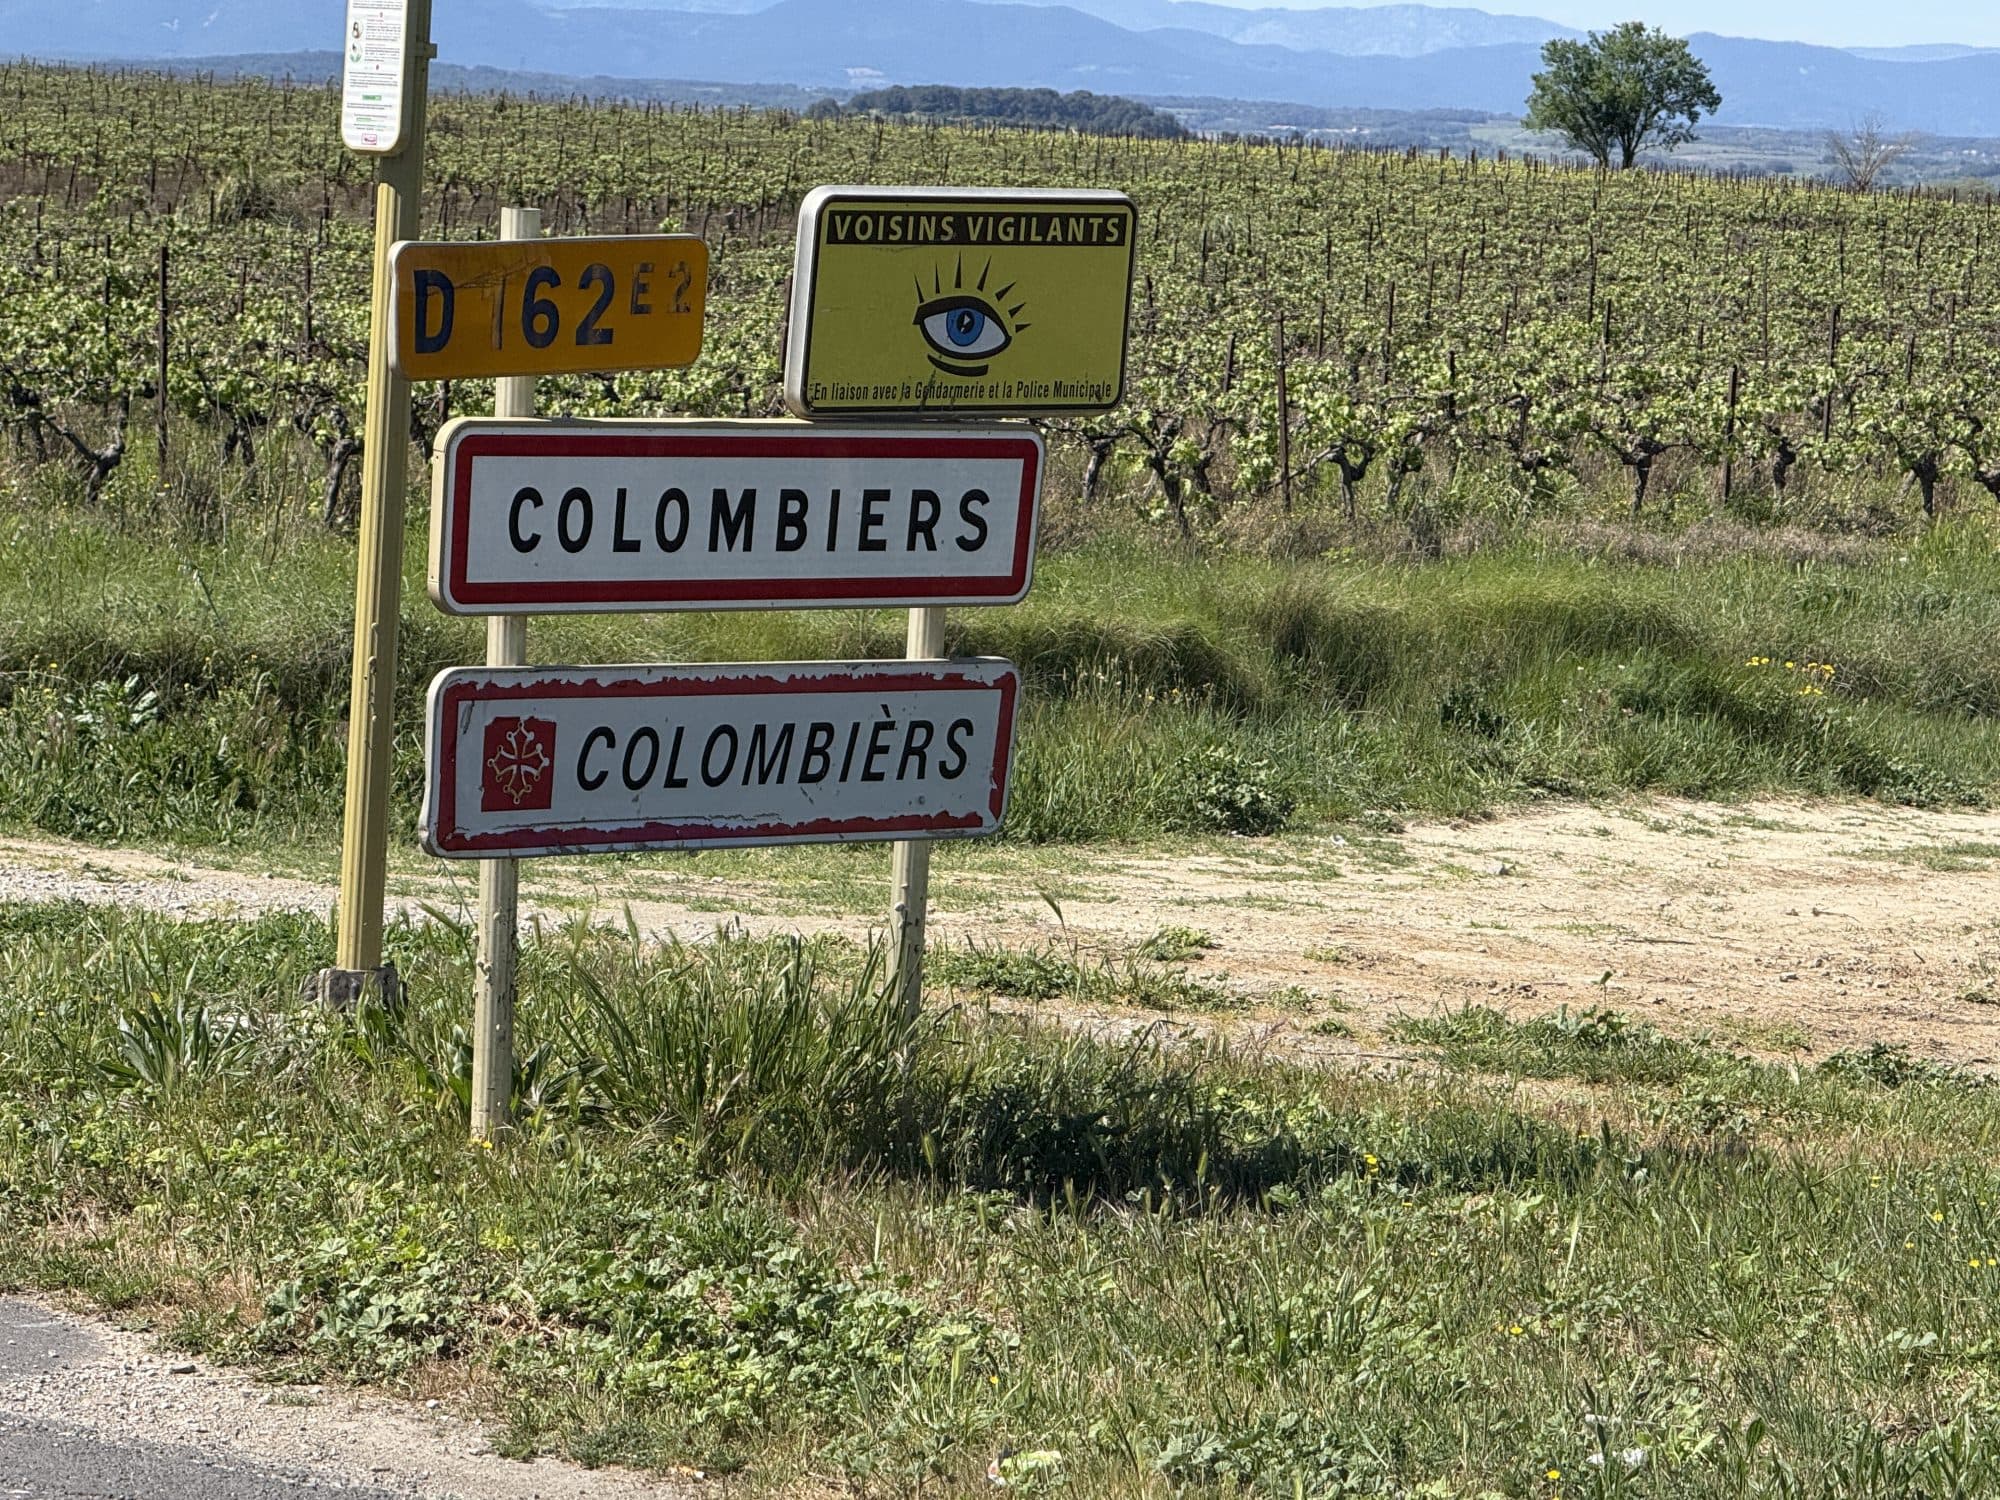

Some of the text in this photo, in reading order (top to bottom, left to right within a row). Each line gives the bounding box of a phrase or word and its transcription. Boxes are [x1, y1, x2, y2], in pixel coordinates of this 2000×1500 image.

[834, 214, 1120, 243] VOISINS VIGILANTS
[413, 269, 455, 353] D
[814, 380, 1112, 402] En liaison avec la Gendarmerie et la Police Municipale
[508, 487, 990, 554] COLOMBIERS
[576, 704, 975, 791] COLOMBIÈRS
